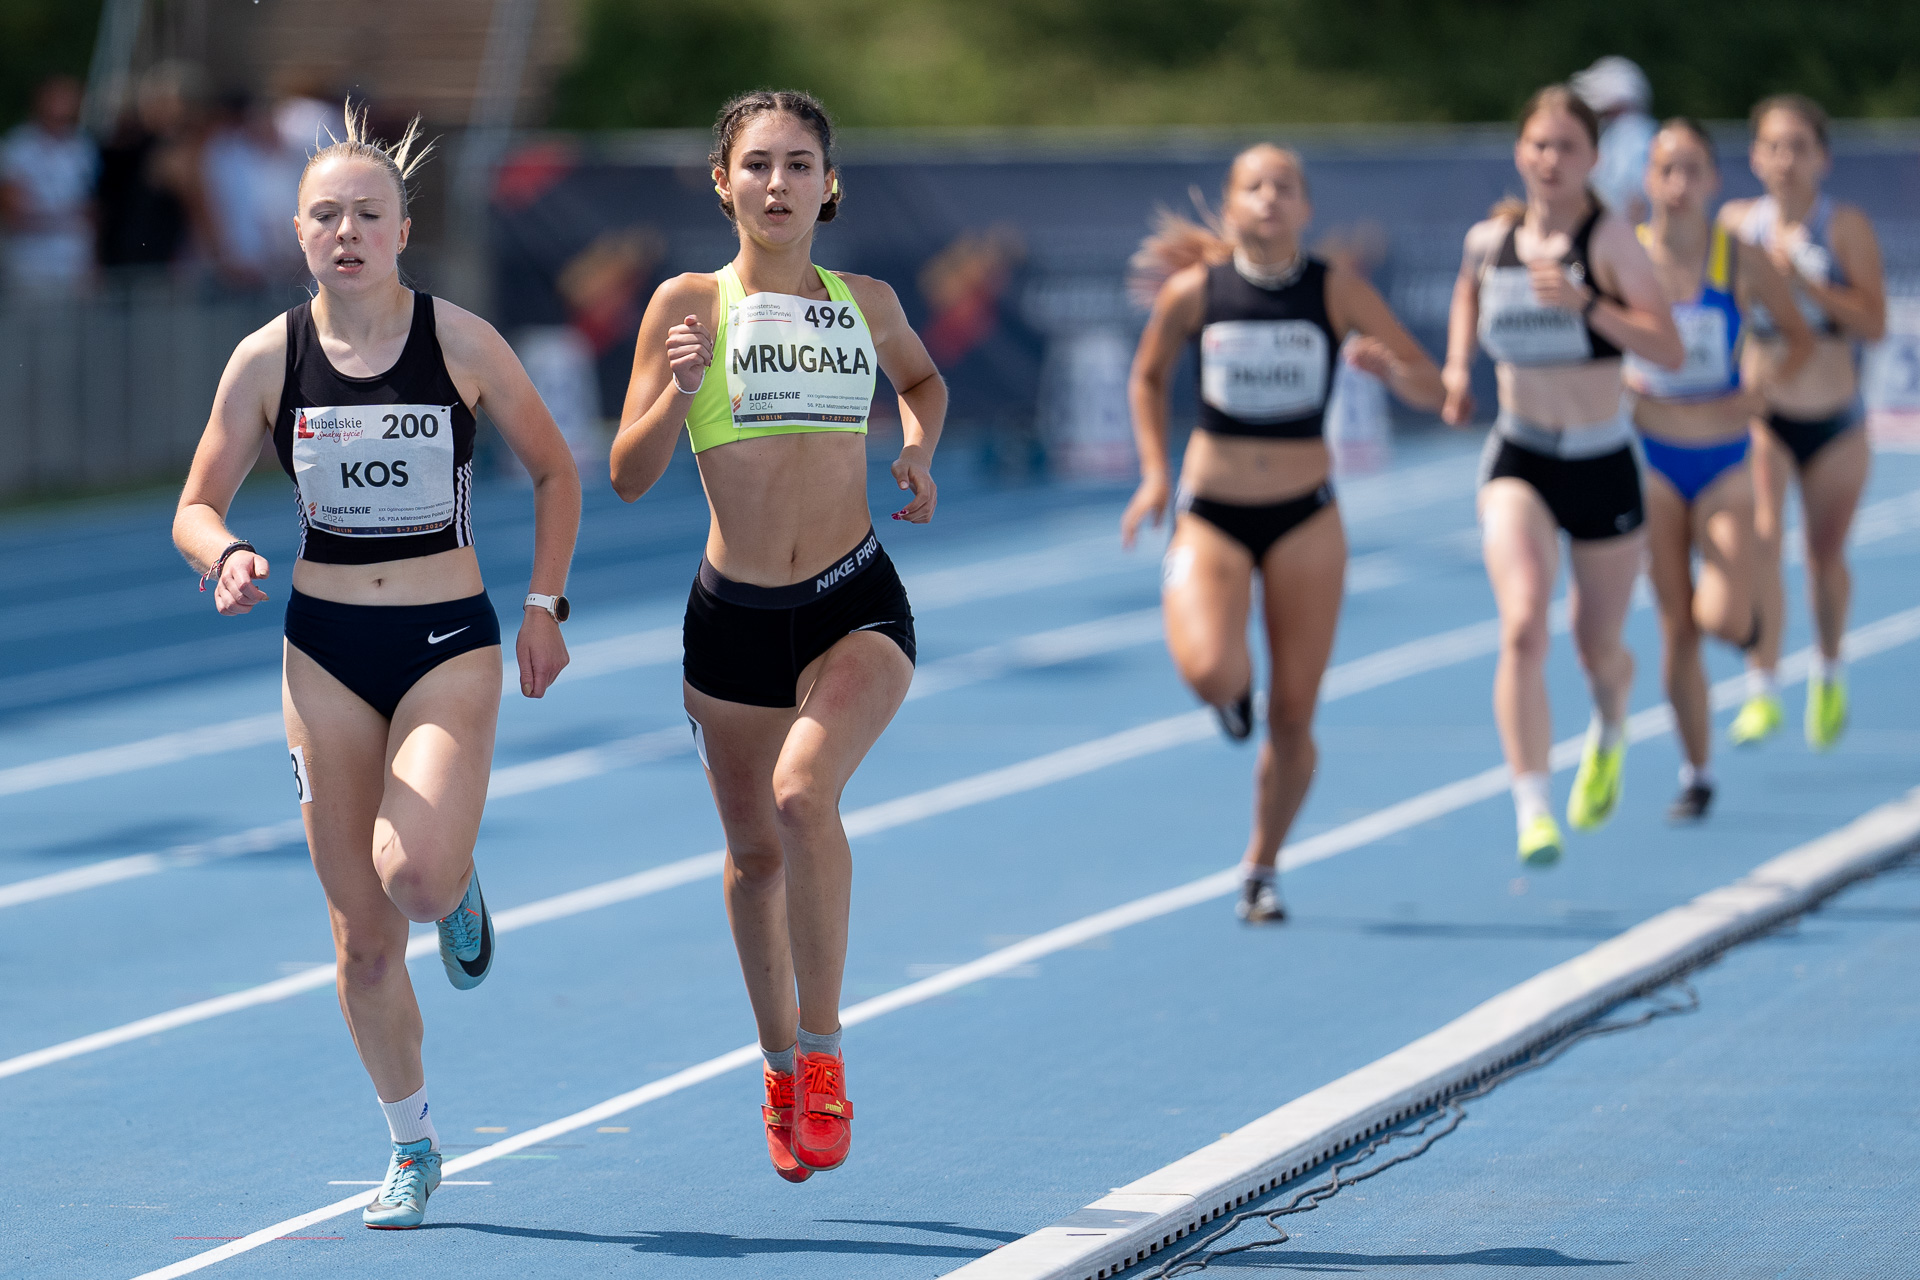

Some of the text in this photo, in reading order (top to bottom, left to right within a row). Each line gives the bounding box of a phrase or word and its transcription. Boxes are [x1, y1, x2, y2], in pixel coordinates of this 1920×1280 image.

[804, 305, 855, 329] 496
[732, 344, 870, 375] MRUGAŁA
[749, 391, 801, 401] LUBELSKIE
[749, 402, 773, 410] 2024
[381, 413, 439, 439] 200
[340, 460, 409, 489] KOS
[321, 505, 371, 514] LUBELSKIE
[322, 513, 344, 523] 2024
[328, 525, 352, 533] LUBLIN
[816, 535, 877, 593] NIKE PRO
